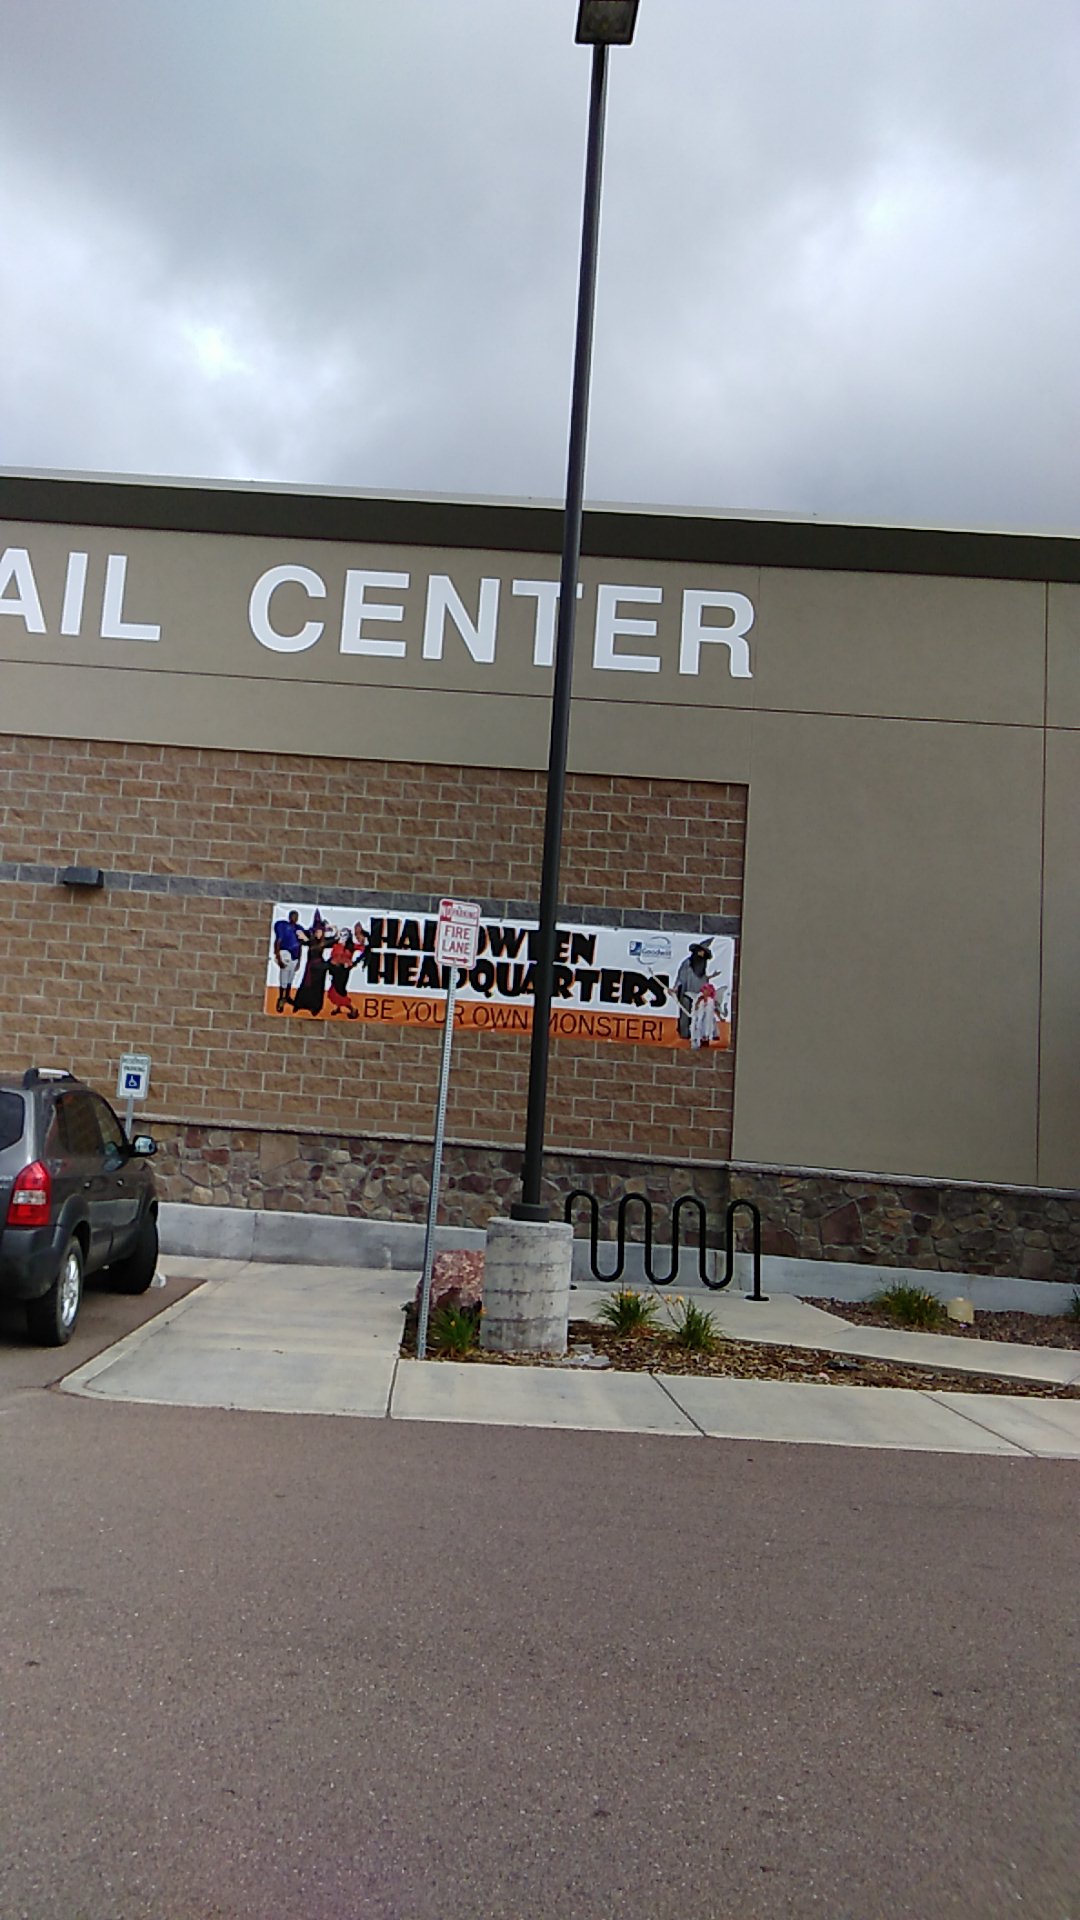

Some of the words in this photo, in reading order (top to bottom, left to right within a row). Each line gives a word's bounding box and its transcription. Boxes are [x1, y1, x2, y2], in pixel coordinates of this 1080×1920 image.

[0, 547, 161, 642] AIL
[248, 564, 757, 679] CENTER
[370, 917, 597, 967] HALWEEN
[442, 939, 471, 955] LANE
[444, 925, 471, 940] FIRE
[366, 952, 670, 1008] HEADQUARTERS
[364, 998, 394, 1020] BE
[402, 1001, 465, 1025] YOUR
[472, 1006, 529, 1030] OWN
